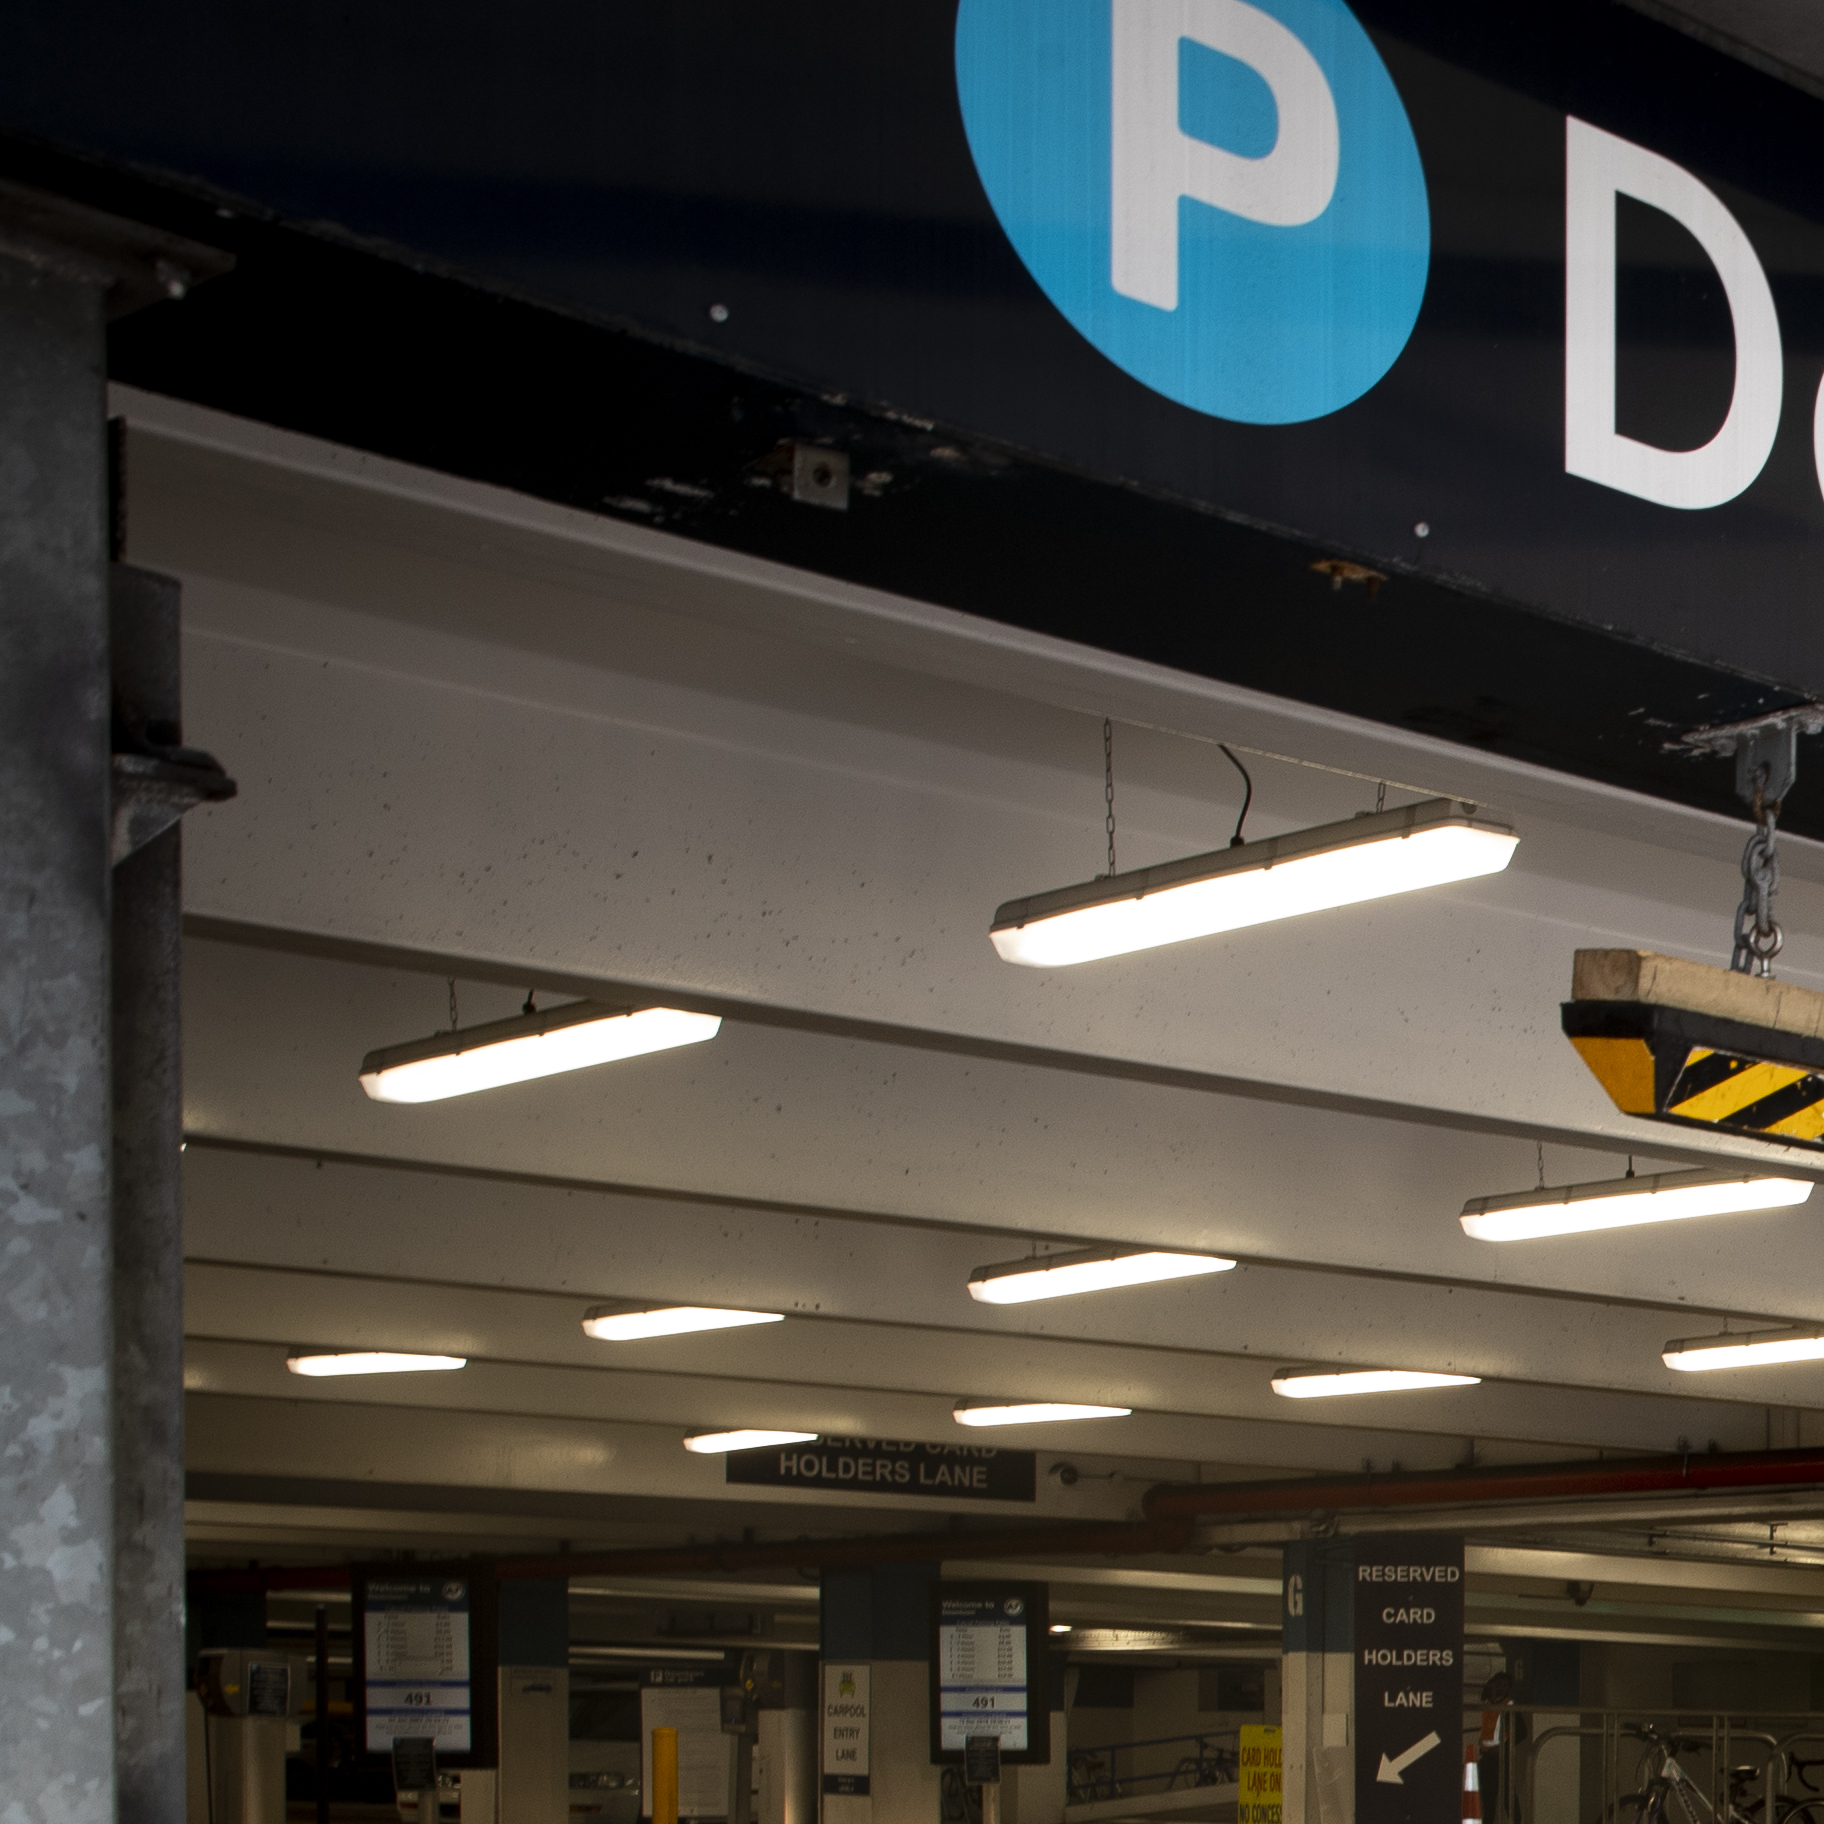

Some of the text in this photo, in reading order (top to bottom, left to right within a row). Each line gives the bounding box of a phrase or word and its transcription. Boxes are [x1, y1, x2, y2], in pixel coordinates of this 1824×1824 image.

[1112, 0, 1339, 311] P
[779, 1452, 989, 1489] HOLDERS LANE
[1357, 1565, 1460, 1583] RESERVED
[1381, 1607, 1436, 1625] CARD
[1363, 1648, 1454, 1667] HOLDERS
[404, 1692, 431, 1706] 491
[972, 1696, 995, 1709] 491
[1383, 1691, 1434, 1708] LANE
[827, 1704, 867, 1719] CARPOOL
[833, 1727, 861, 1741] ENTRY
[836, 1749, 858, 1762] LANE
[1241, 1746, 1261, 1767] CARD
[1248, 1771, 1267, 1793] LANE
[1239, 1803, 1250, 1824] NO
